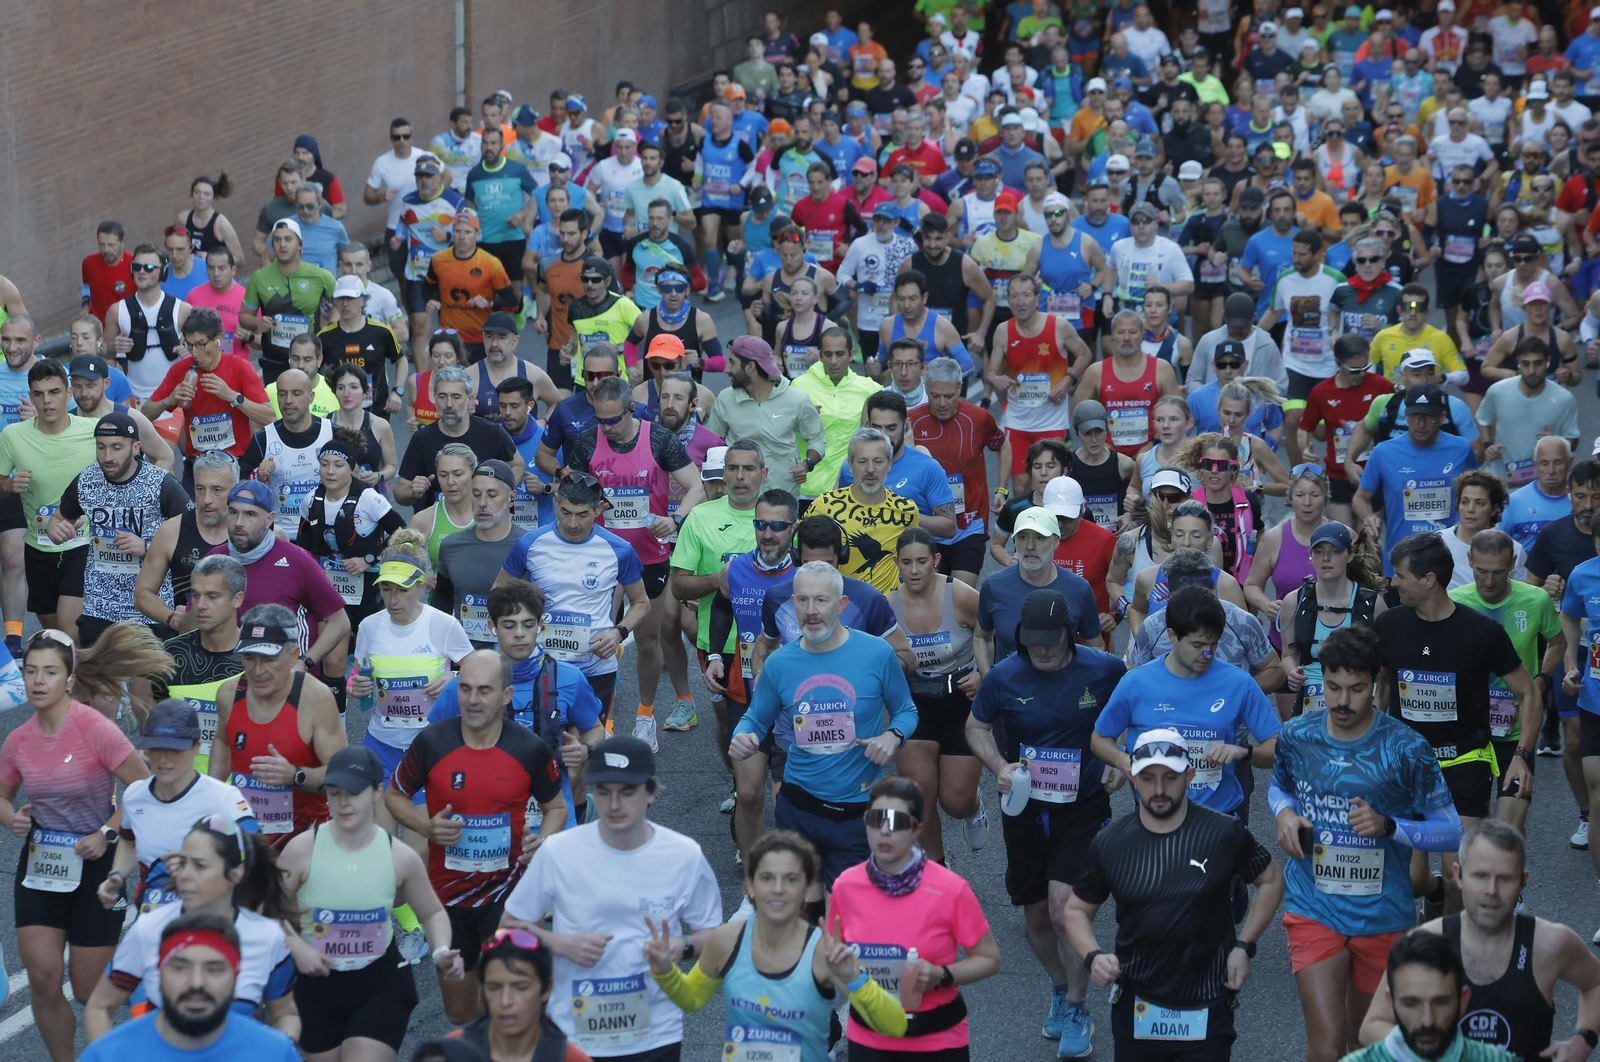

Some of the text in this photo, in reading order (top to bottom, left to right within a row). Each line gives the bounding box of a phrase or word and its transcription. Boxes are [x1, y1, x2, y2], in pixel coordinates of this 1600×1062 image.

[1018, 392, 1047, 400] ANTONIO
[417, 408, 439, 418] SERPE
[202, 414, 227, 423] ZURICH
[198, 432, 228, 444] CARLOS
[1408, 500, 1446, 510] HERBERT
[511, 514, 538, 522] ARRIOLA
[614, 509, 638, 518] CACO
[1094, 516, 1110, 524] RTA
[100, 550, 132, 562] POMELO
[742, 588, 766, 596] FUND
[736, 608, 757, 616] Contra
[555, 616, 585, 624] ZURICH
[554, 628, 572, 637] 11727
[545, 638, 579, 650] BRUNO
[916, 636, 944, 644] ZURICH
[916, 650, 936, 658] 12146
[392, 679, 422, 688] ZURICH
[1418, 674, 1449, 683] ZURICH
[1416, 688, 1437, 697] 11476
[1490, 689, 1514, 698] URICH
[814, 702, 846, 711] ZURICH
[1400, 698, 1456, 710] NACHO RUIZ
[387, 704, 424, 716] ANABEL
[816, 718, 834, 727] 9352
[808, 728, 845, 742] JAMES
[1182, 730, 1218, 738] ZURICH
[1040, 750, 1074, 760] ZURICH
[1040, 766, 1058, 775] 9529
[1044, 781, 1058, 790] THE
[1060, 782, 1078, 791] BULL
[250, 796, 268, 806] 8919
[263, 812, 292, 821] NEBOT
[467, 816, 502, 827] ZURICH
[43, 834, 78, 846] ZURICH
[468, 835, 488, 844] 6445
[1338, 836, 1376, 846] ZURICH
[473, 844, 509, 858] RAMÓN
[41, 852, 62, 862] 12404
[1335, 854, 1360, 863] 10322
[34, 862, 69, 878] SARAH
[1315, 864, 1380, 880] DANI RUIZ
[338, 910, 380, 922] ZURICH
[339, 930, 360, 938] 9775
[325, 940, 374, 956] MOLLIE
[864, 946, 902, 956] ZURICH
[598, 980, 640, 992] ZURICH
[597, 1002, 626, 1012] 11373
[764, 1006, 806, 1020] POWER
[1160, 1010, 1181, 1018] 5288
[588, 1014, 636, 1032] DANNY
[1469, 1016, 1498, 1031] CDF
[1150, 1022, 1190, 1036] ADAM
[747, 1028, 792, 1042] ZURICH
[746, 1050, 774, 1060] 12395
